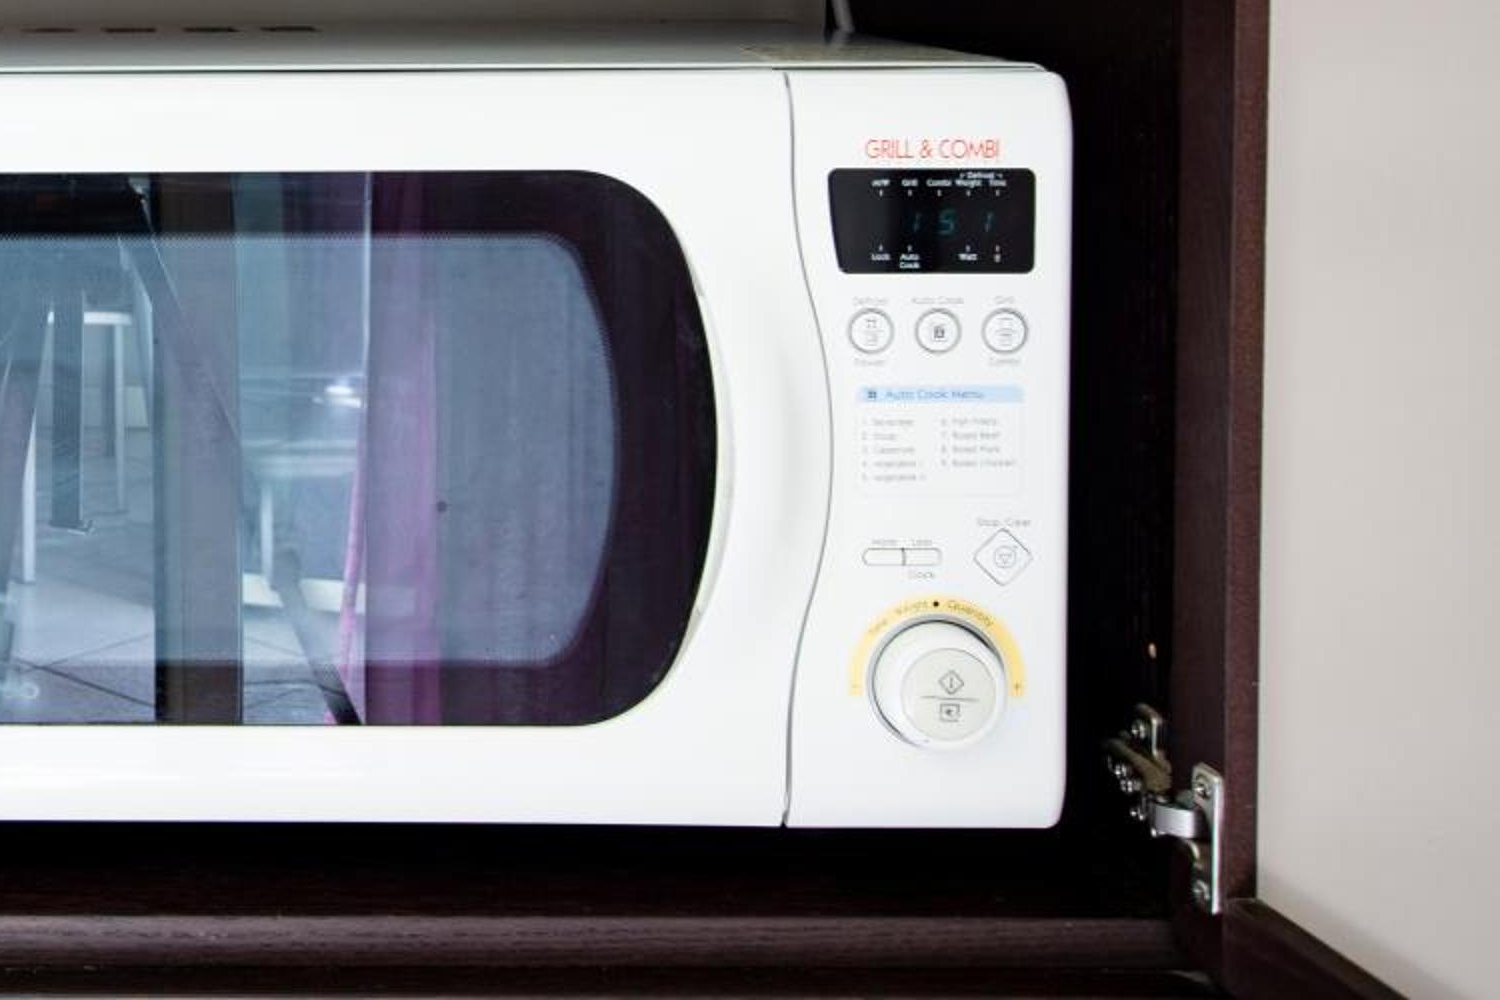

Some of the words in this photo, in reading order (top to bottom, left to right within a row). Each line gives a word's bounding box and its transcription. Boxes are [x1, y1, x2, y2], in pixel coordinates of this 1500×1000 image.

[866, 139, 914, 159] GRILL
[919, 139, 933, 159] &
[939, 139, 1000, 159] COMBI
[885, 389, 915, 400] Auto
[917, 388, 949, 400] Cook
[951, 390, 985, 400] Menu
